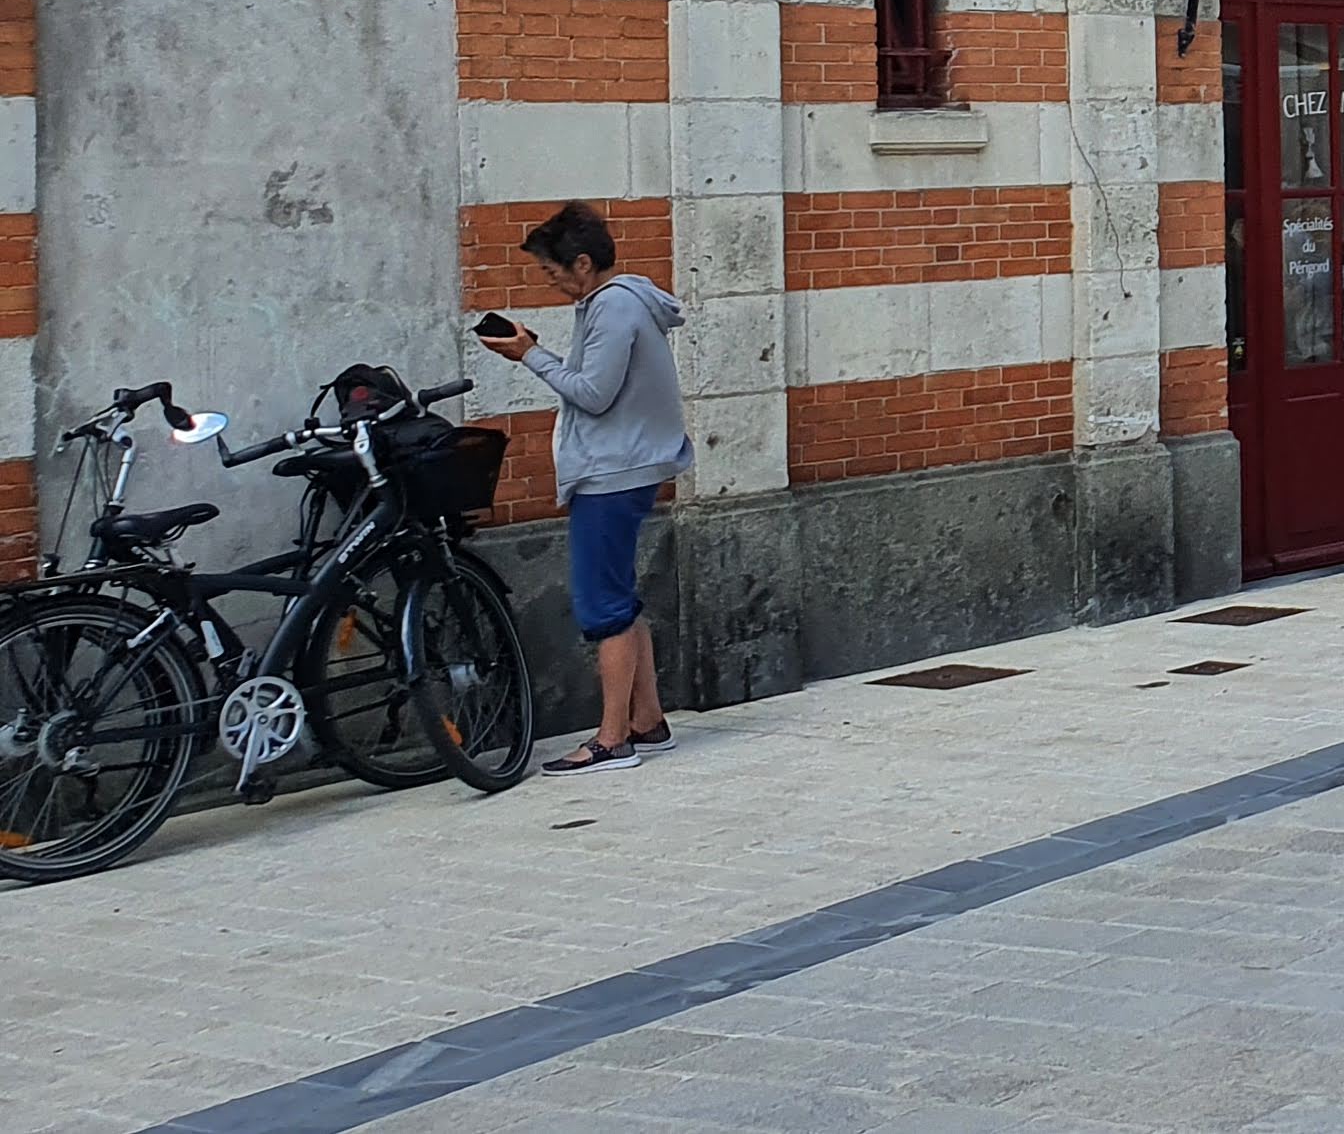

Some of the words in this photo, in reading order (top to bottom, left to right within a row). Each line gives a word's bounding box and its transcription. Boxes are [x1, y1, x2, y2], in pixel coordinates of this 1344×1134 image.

[1283, 91, 1327, 118] CHEZ
[1283, 216, 1333, 237] Spécialités
[1302, 239, 1316, 253] du
[1289, 258, 1330, 279] Périgord
